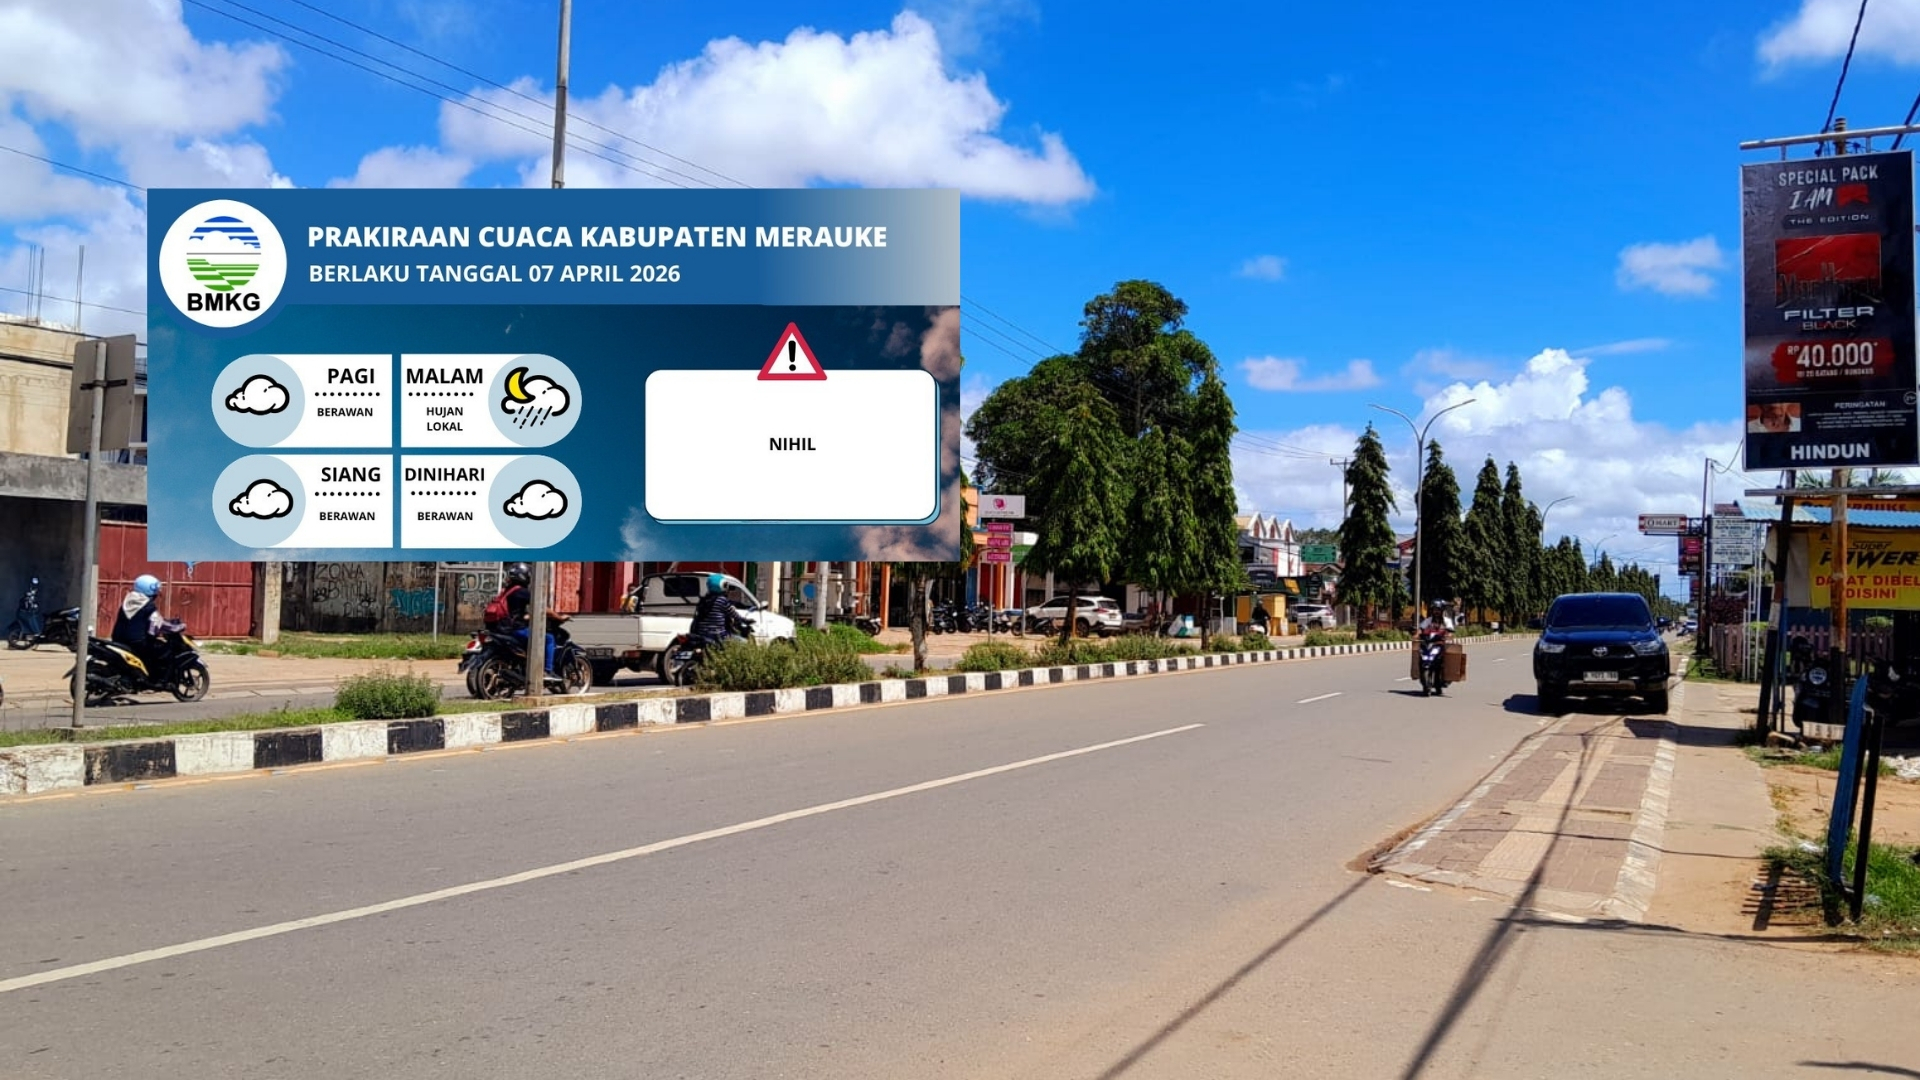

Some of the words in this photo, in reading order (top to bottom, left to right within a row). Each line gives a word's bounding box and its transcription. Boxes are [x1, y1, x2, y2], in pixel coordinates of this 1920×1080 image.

[1779, 168, 1837, 186] SPECIAL
[1842, 165, 1878, 181] PACK
[1789, 190, 1804, 210] I
[1804, 187, 1833, 211] AM
[1820, 214, 1869, 224] EDITION
[1784, 306, 1875, 321] FILTER
[1802, 319, 1857, 331] BLACK
[1834, 401, 1886, 409] PERINGATAN
[1790, 443, 1871, 460] HINDUN
[1852, 540, 1892, 550] Super
[1815, 575, 1867, 587] DAAT
[1846, 587, 1897, 599] DISINI
